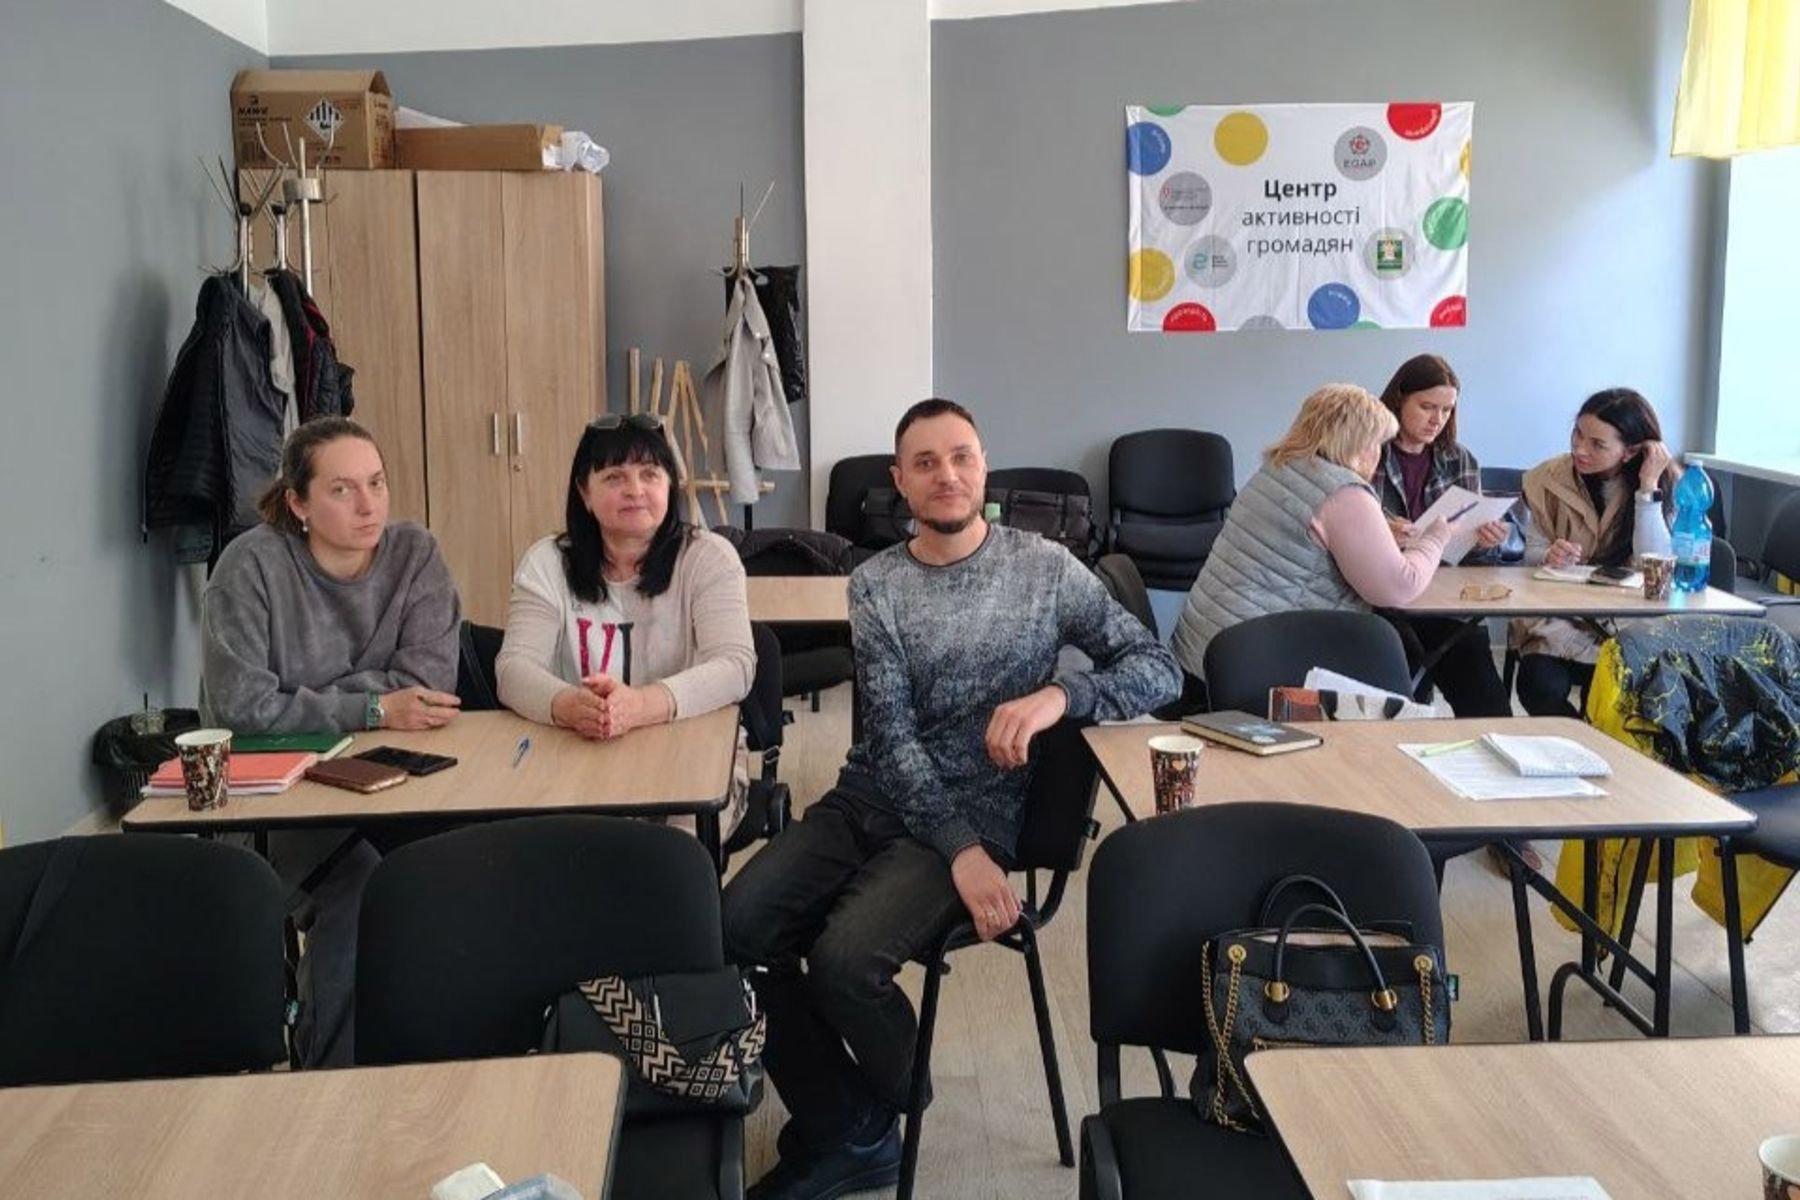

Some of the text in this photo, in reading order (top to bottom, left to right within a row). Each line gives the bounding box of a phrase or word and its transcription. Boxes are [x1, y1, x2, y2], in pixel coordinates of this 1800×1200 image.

[1264, 179, 1338, 202] Центр
[1241, 206, 1360, 226] активності
[1247, 238, 1353, 258] громадян
